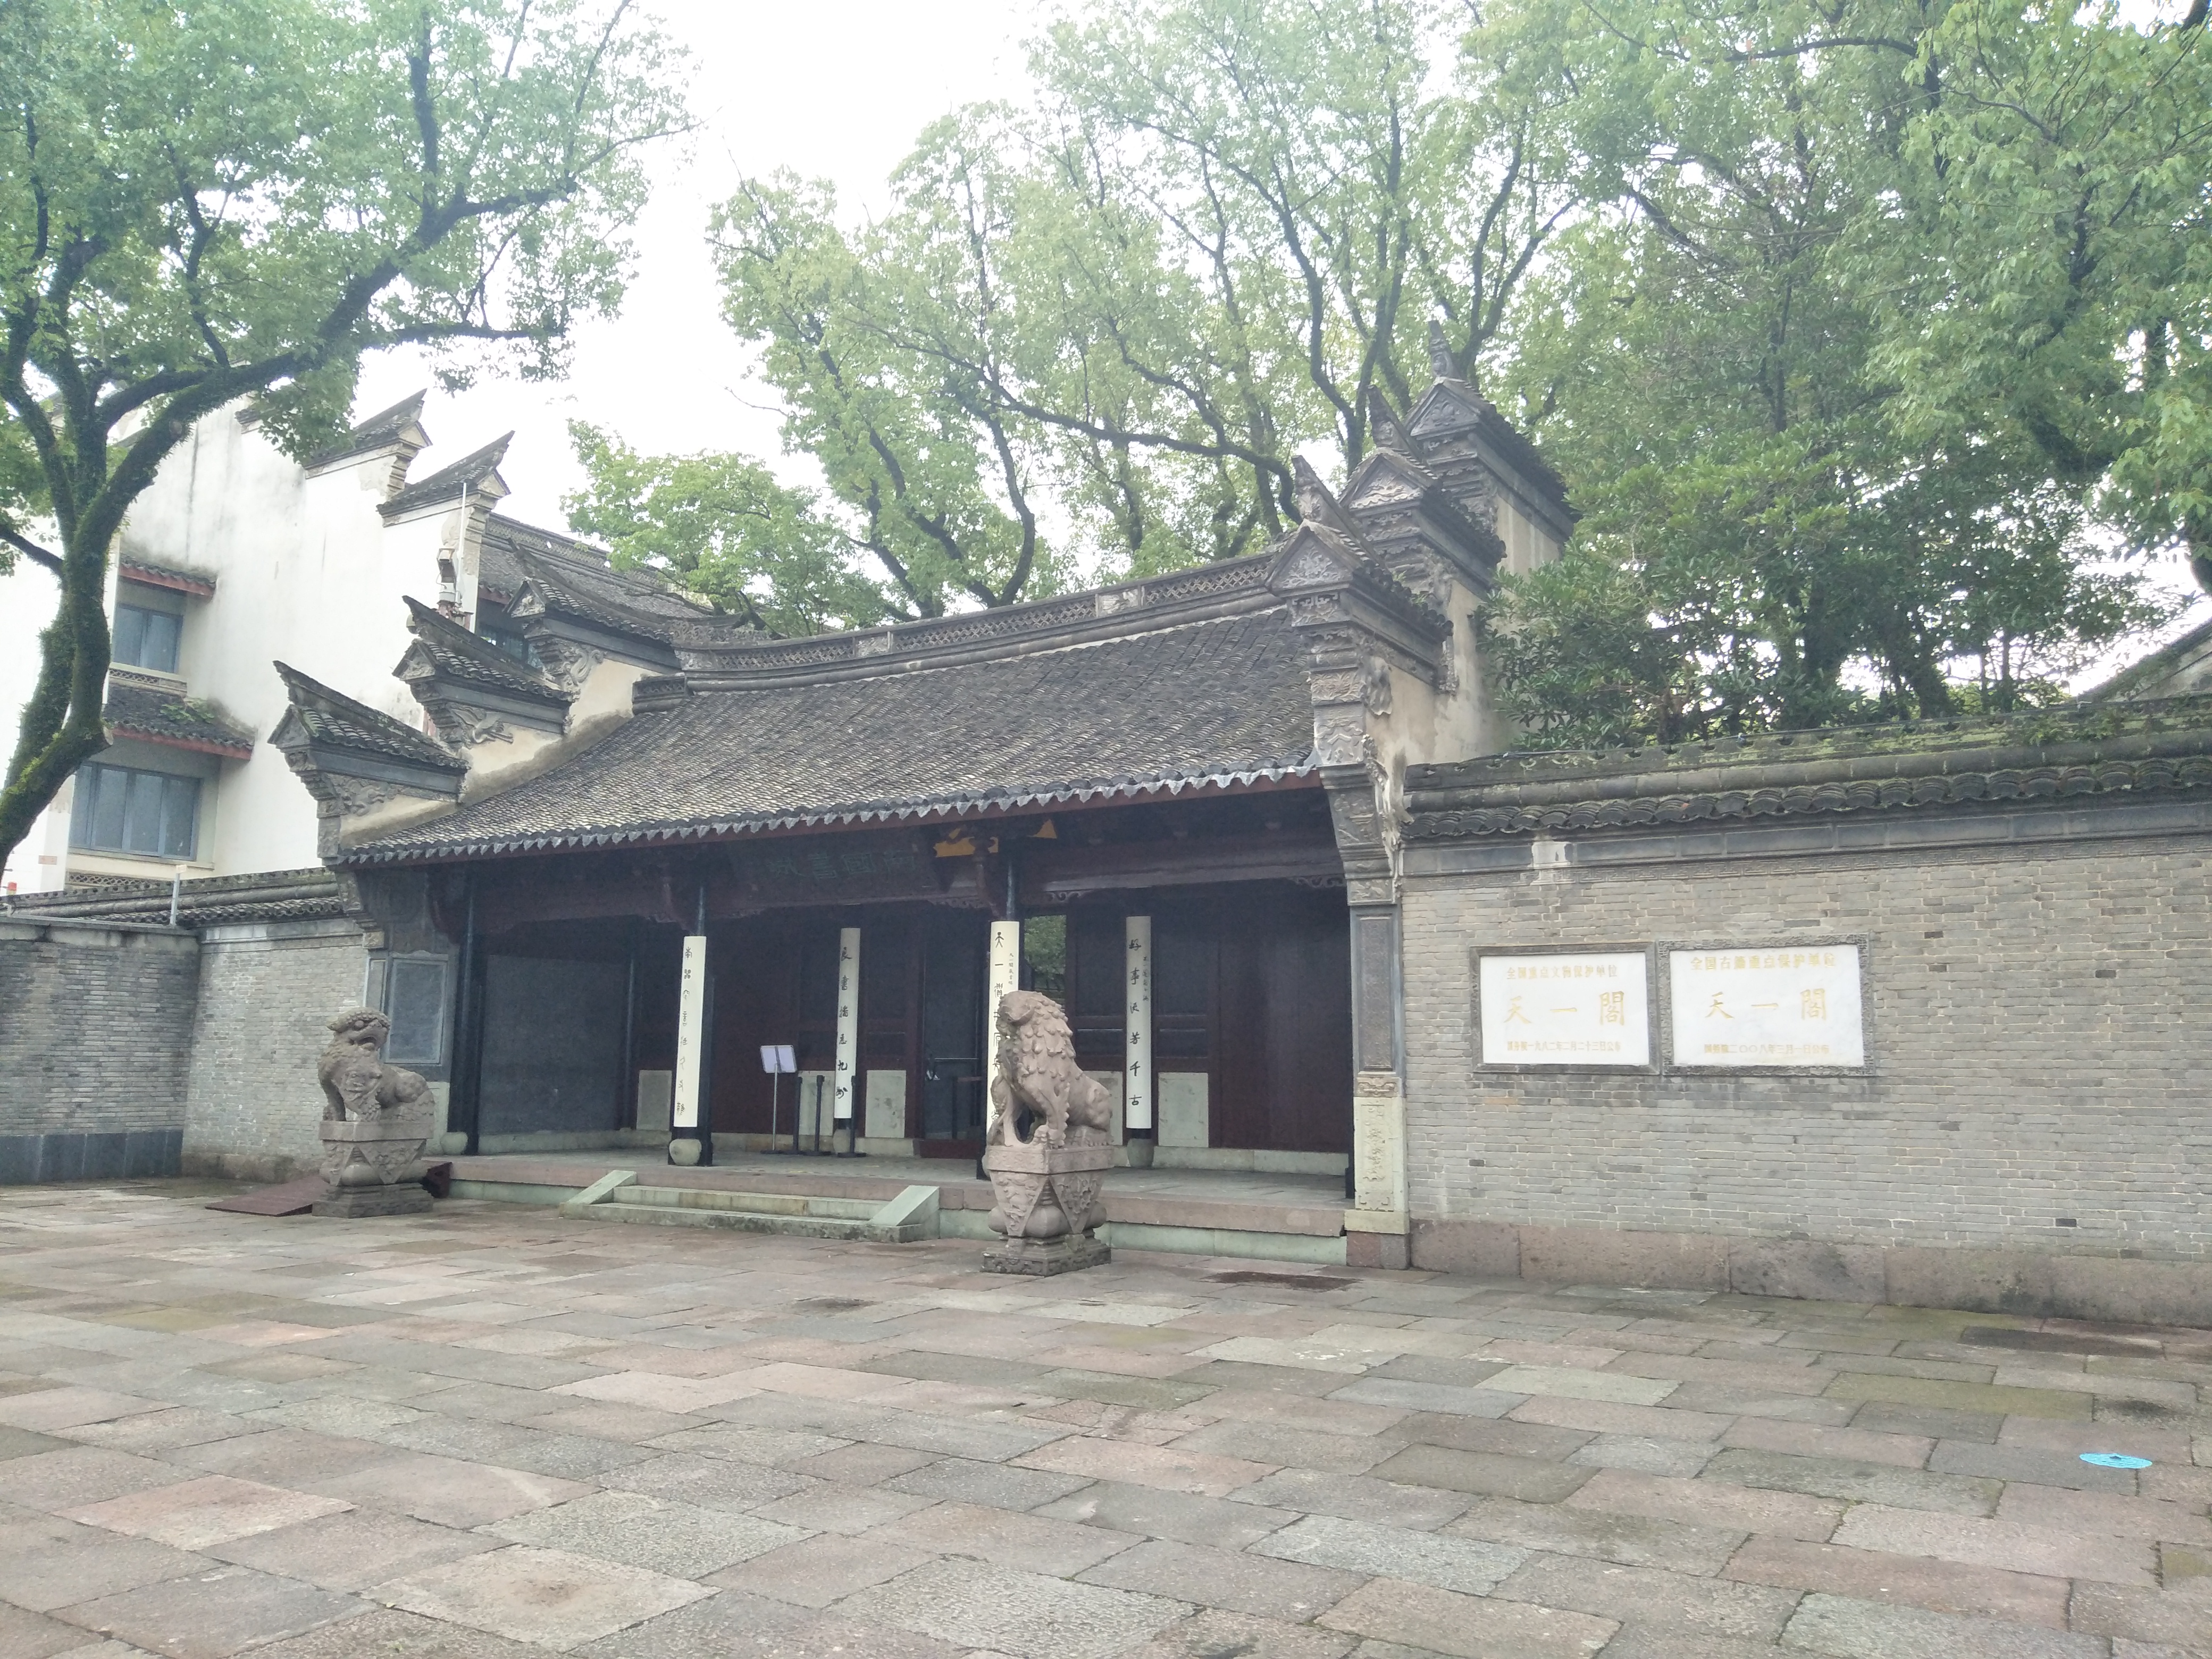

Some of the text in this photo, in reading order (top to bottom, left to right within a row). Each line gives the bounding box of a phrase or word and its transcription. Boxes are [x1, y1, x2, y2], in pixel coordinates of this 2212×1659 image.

[1507, 965, 1618, 979] 全国重点文物保护单位
[1690, 952, 1836, 971] 全国古籍重点保护单位
[1504, 991, 1625, 1026] 天一閣
[1705, 987, 1827, 1021] 天一閣
